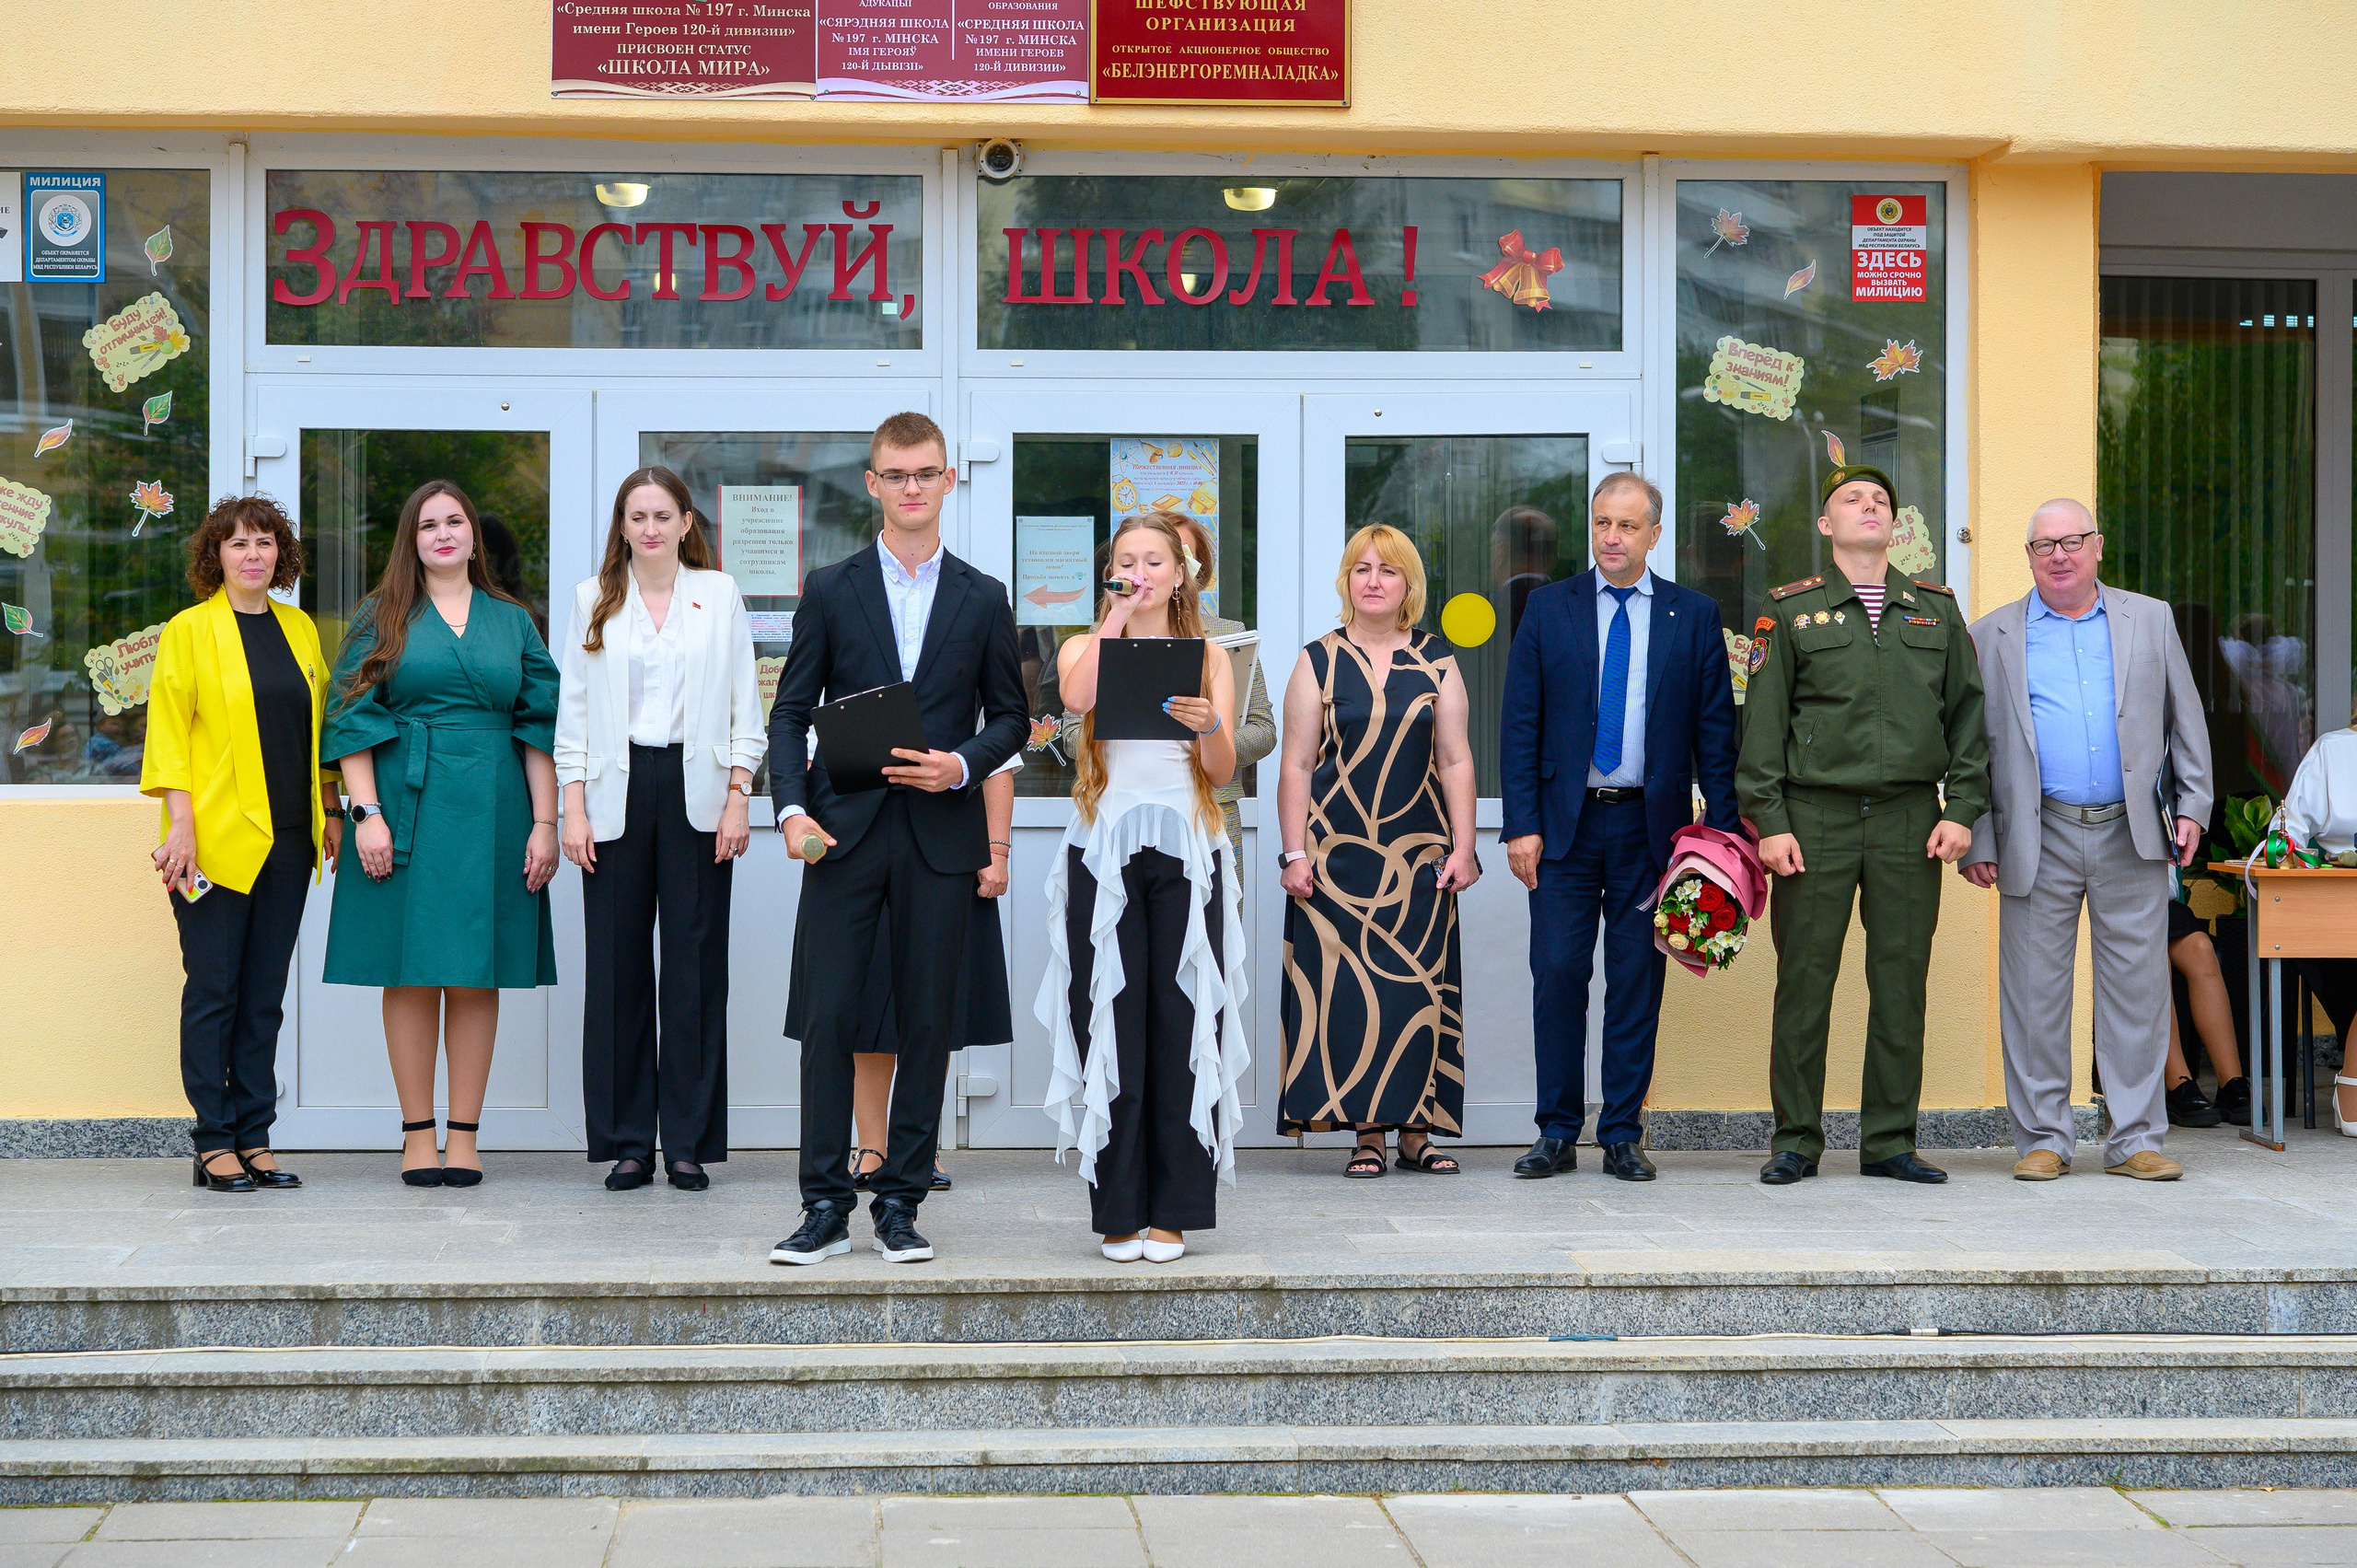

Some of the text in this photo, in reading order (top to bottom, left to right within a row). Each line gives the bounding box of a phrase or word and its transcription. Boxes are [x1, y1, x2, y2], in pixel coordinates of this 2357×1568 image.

[557, 2, 811, 17] «Средняя школа № 197 г. Минска
[988, 2, 1058, 10] ОБРАЗОВАНИЯ
[1135, 0, 1306, 13] ШЕФСТВУЮЩАЯ
[573, 22, 795, 39] имени Героев 120-й дивизии»
[819, 17, 949, 30] «СЯРЭДНЯЯ ШКОЛА
[957, 18, 1085, 32] «СРЕДНЯЯ ШКОЛА
[1145, 17, 1296, 34] ОРГАНИЗАЦИЯ
[872, 36, 882, 44] г.
[884, 33, 939, 45] МІНСКА
[1005, 37, 1016, 45] г.
[1018, 35, 1077, 46] МИНСКА
[616, 43, 751, 55] ПРИСВОЕН СТАТУС
[848, 45, 917, 57] ІМЯ ГЕРОЯЎ
[975, 48, 1064, 58] ИМЕНИ ГЕРОЕВ
[1111, 44, 1329, 56] ОТКРЫТОЕ АКЦИОНЕРНОЕ ОБЩЕСТВО
[598, 60, 771, 76] «ШКОЛА МИРА»
[842, 60, 870, 71] 120-Й
[974, 61, 1066, 74] 120-Й ДИВИЗИИ»
[1102, 63, 1339, 84] «БЕЛЭНЕРГОРЕМНАЛАДКА»
[29, 177, 101, 188] МИЛИЦИЯ
[273, 200, 915, 321] ЗДРАВСТВУЙ,
[1857, 251, 1922, 271] ЗДЕСЬ
[1855, 286, 1923, 299] МИЛИЦИЮ
[109, 309, 142, 332] Буду
[99, 307, 168, 355] отличницей!
[1727, 342, 1795, 372] Вперёд к
[1725, 361, 1791, 388] знаниям!
[0, 485, 43, 511] же жду
[732, 494, 793, 502] ВНИМАНИЕ!
[0, 499, 36, 521] енние
[0, 514, 38, 538] кулы...
[1904, 514, 1915, 525] в
[120, 651, 157, 676] учить
